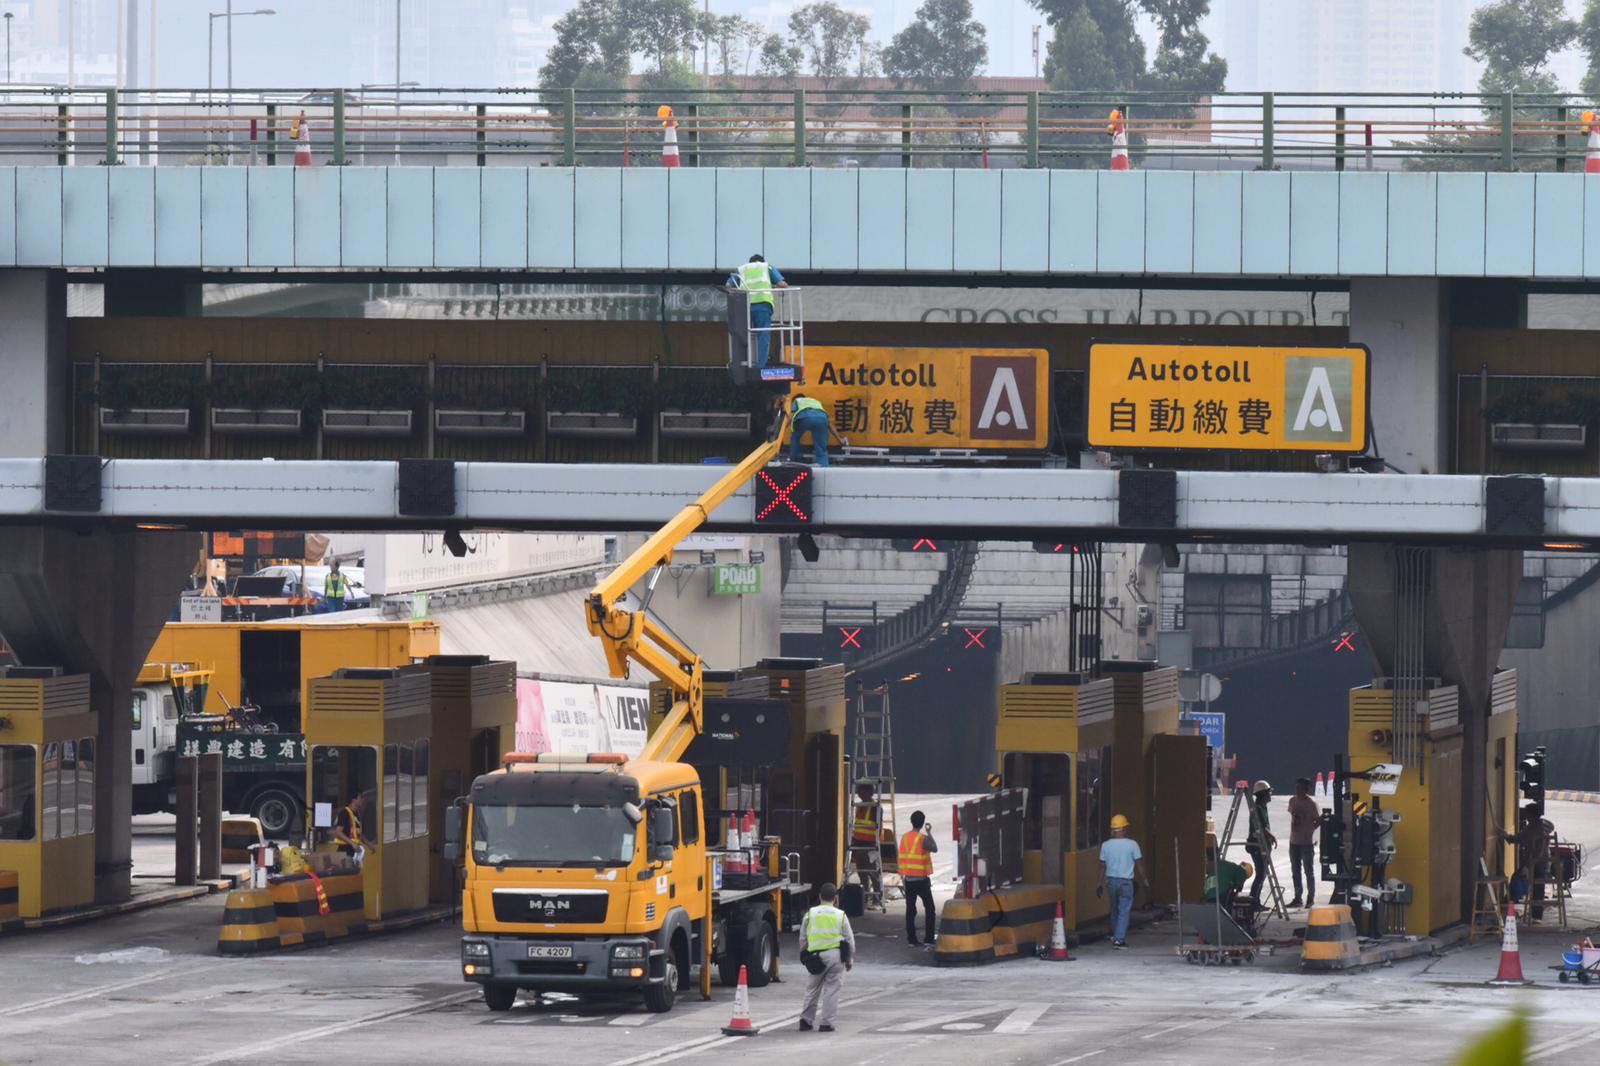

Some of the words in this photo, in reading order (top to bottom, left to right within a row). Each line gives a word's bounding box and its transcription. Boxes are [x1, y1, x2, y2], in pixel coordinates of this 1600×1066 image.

[818, 362, 937, 388] Autotoll
[1127, 356, 1251, 383] Autotoll
[834, 398, 958, 436] 動繳費
[1109, 397, 1273, 436] 自動繳費
[719, 567, 757, 585] POAD
[529, 900, 570, 909] MAN
[530, 947, 544, 957] FC
[546, 947, 570, 957] 4207
